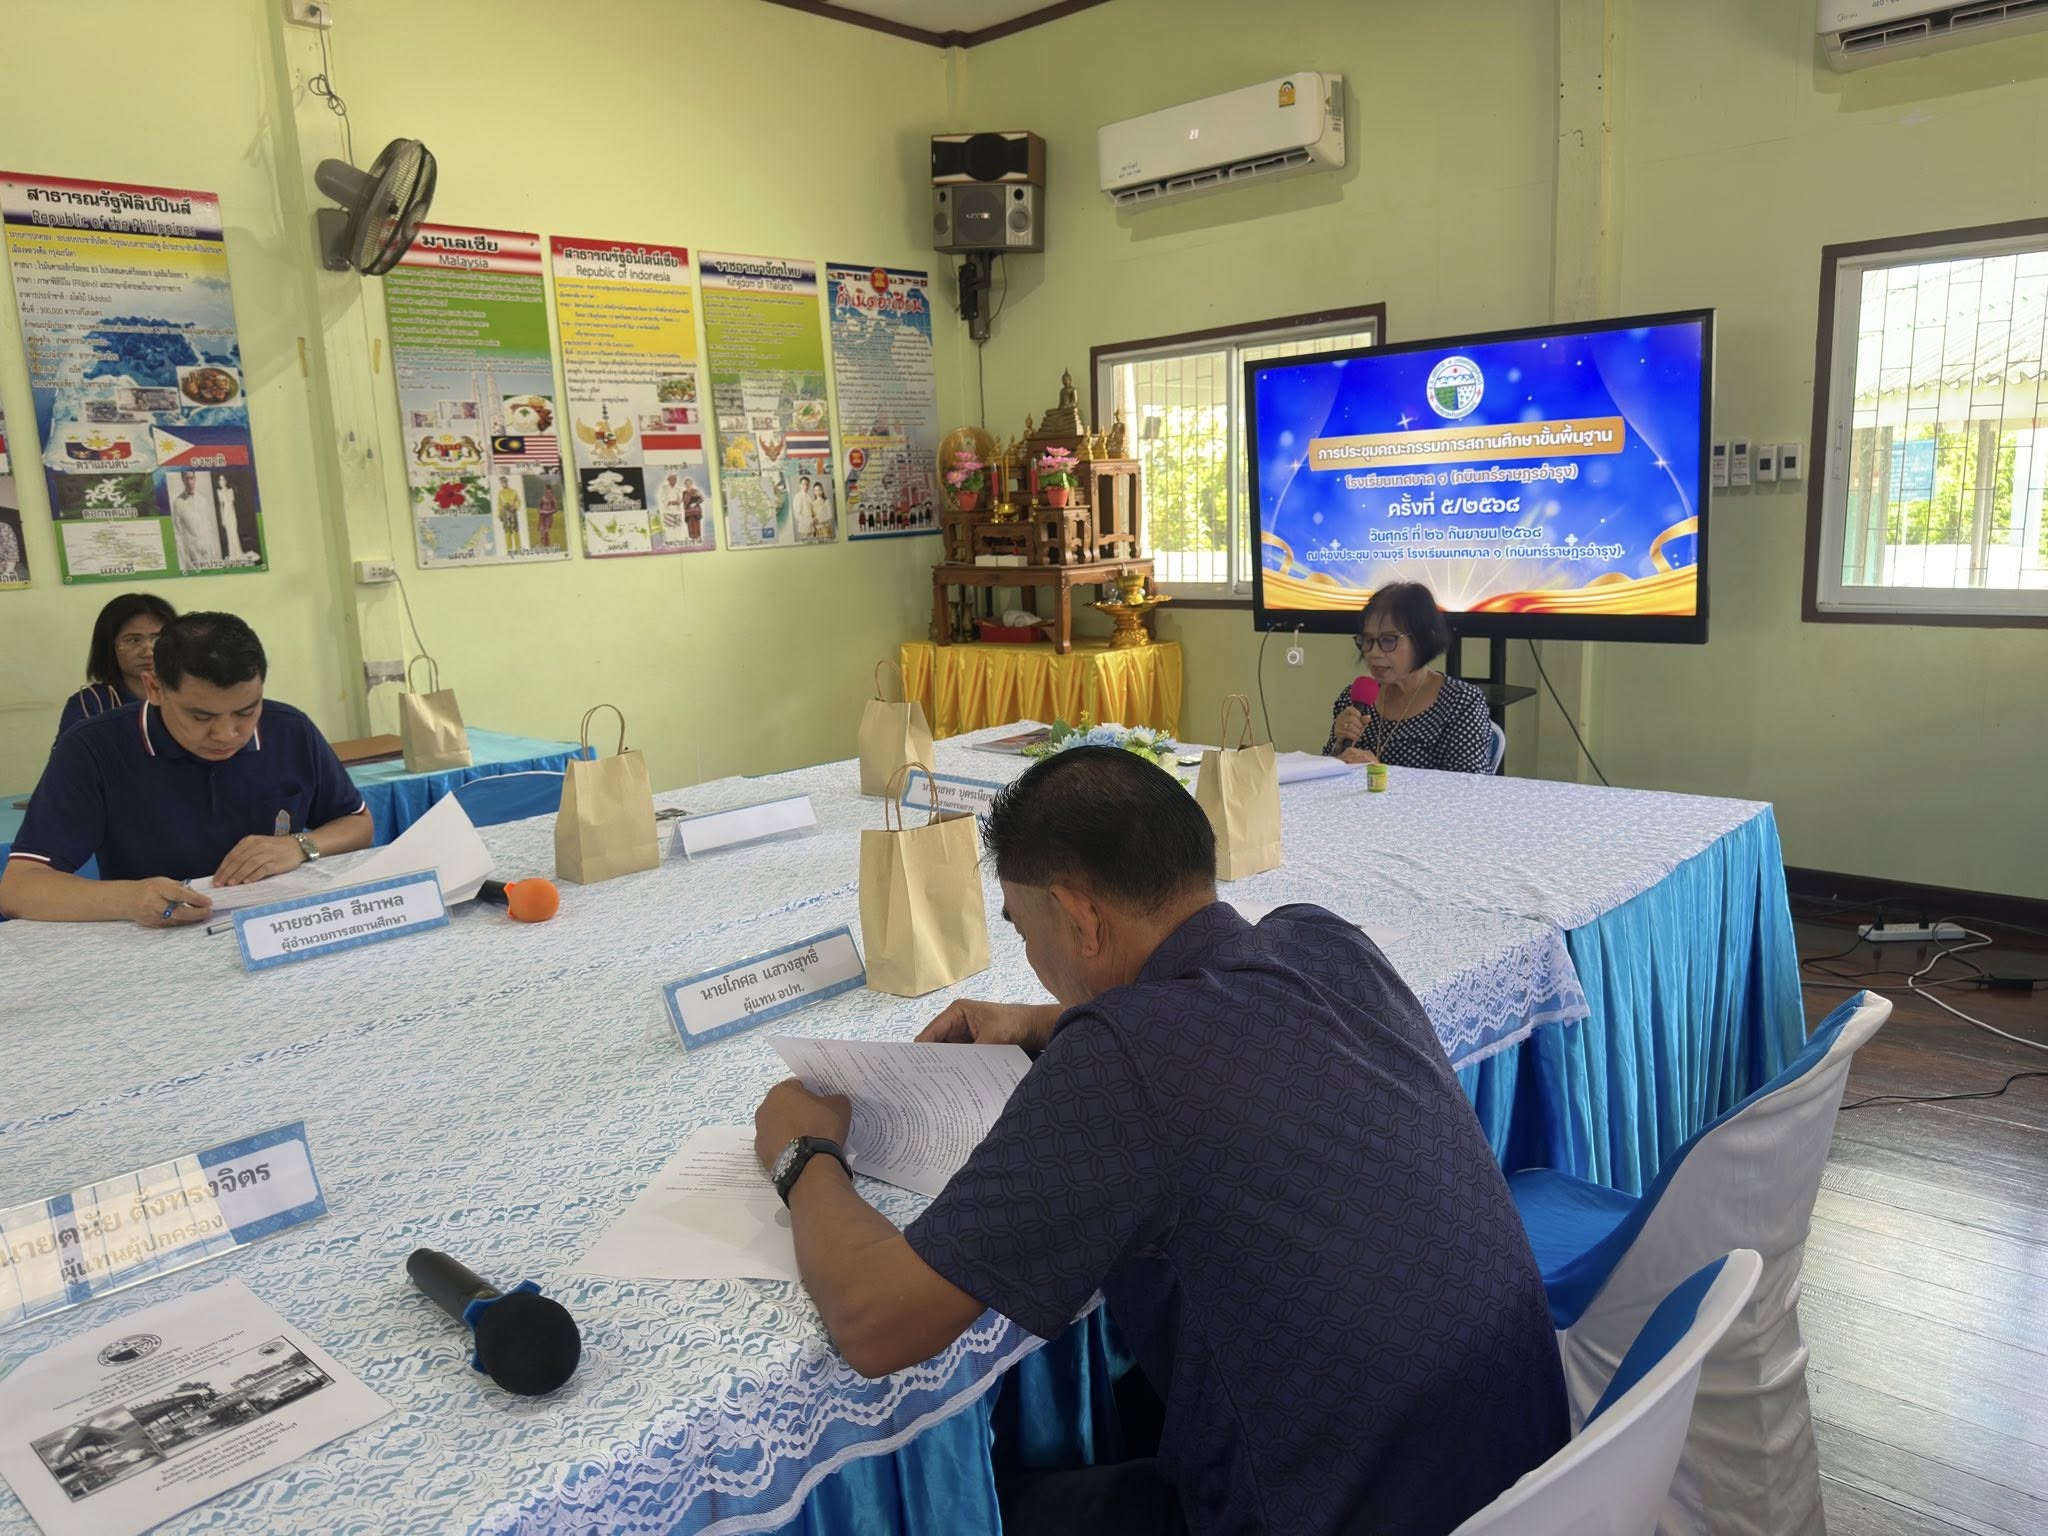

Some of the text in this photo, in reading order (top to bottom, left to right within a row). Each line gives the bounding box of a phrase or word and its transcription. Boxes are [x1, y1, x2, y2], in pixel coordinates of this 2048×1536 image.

[27, 188, 192, 215] สาธารณรัฐฟิลิปปินส์
[32, 210, 197, 237] Republic of the Philippines
[422, 235, 498, 251] มาเลเซีย
[440, 255, 489, 269] Malaysia
[565, 248, 678, 267] สาธารณรัฐอินโดนีเซีย
[716, 261, 801, 278] ราชอาณาจักรไทย
[576, 265, 671, 282] Republic of Indonesia
[727, 277, 793, 291] Kingdom of Thailand
[1318, 424, 1613, 462] การประชุมคณะกรรมการสถานศึกษาขั้นพื้นฐาน
[1346, 473, 1435, 489] โรงเรียนเทศบาล
[1451, 463, 1579, 485] (กบินทร์ราษฎรอำรุง)
[1388, 491, 1520, 517] ครั้งที่ ๕/๒๕๖๘
[1370, 523, 1543, 545] วันศุกร์ ที่ ๒๖ กันยายน ๒๕๖๘
[1307, 550, 1318, 561] ณ
[1320, 546, 1370, 563] ห้องประชุม
[1373, 549, 1404, 563] จามจุรี
[1407, 547, 1490, 559] โรงเรียนเทศบาล
[1506, 543, 1623, 561] (กบินทร์ราษฎรอำรุง)
[270, 893, 405, 934] นายชวลิต สีมาพล
[281, 913, 408, 952] ผู้อำนวยการสถานศึกษา
[700, 944, 820, 1001] นายโกศล แสวงสุทธิ์
[743, 983, 805, 1015] ผู้แทน อปท.
[130, 1162, 272, 1223] ตั้งทรงจิตร
[61, 1214, 224, 1285] ผู้แทนผู้ปกครอง
